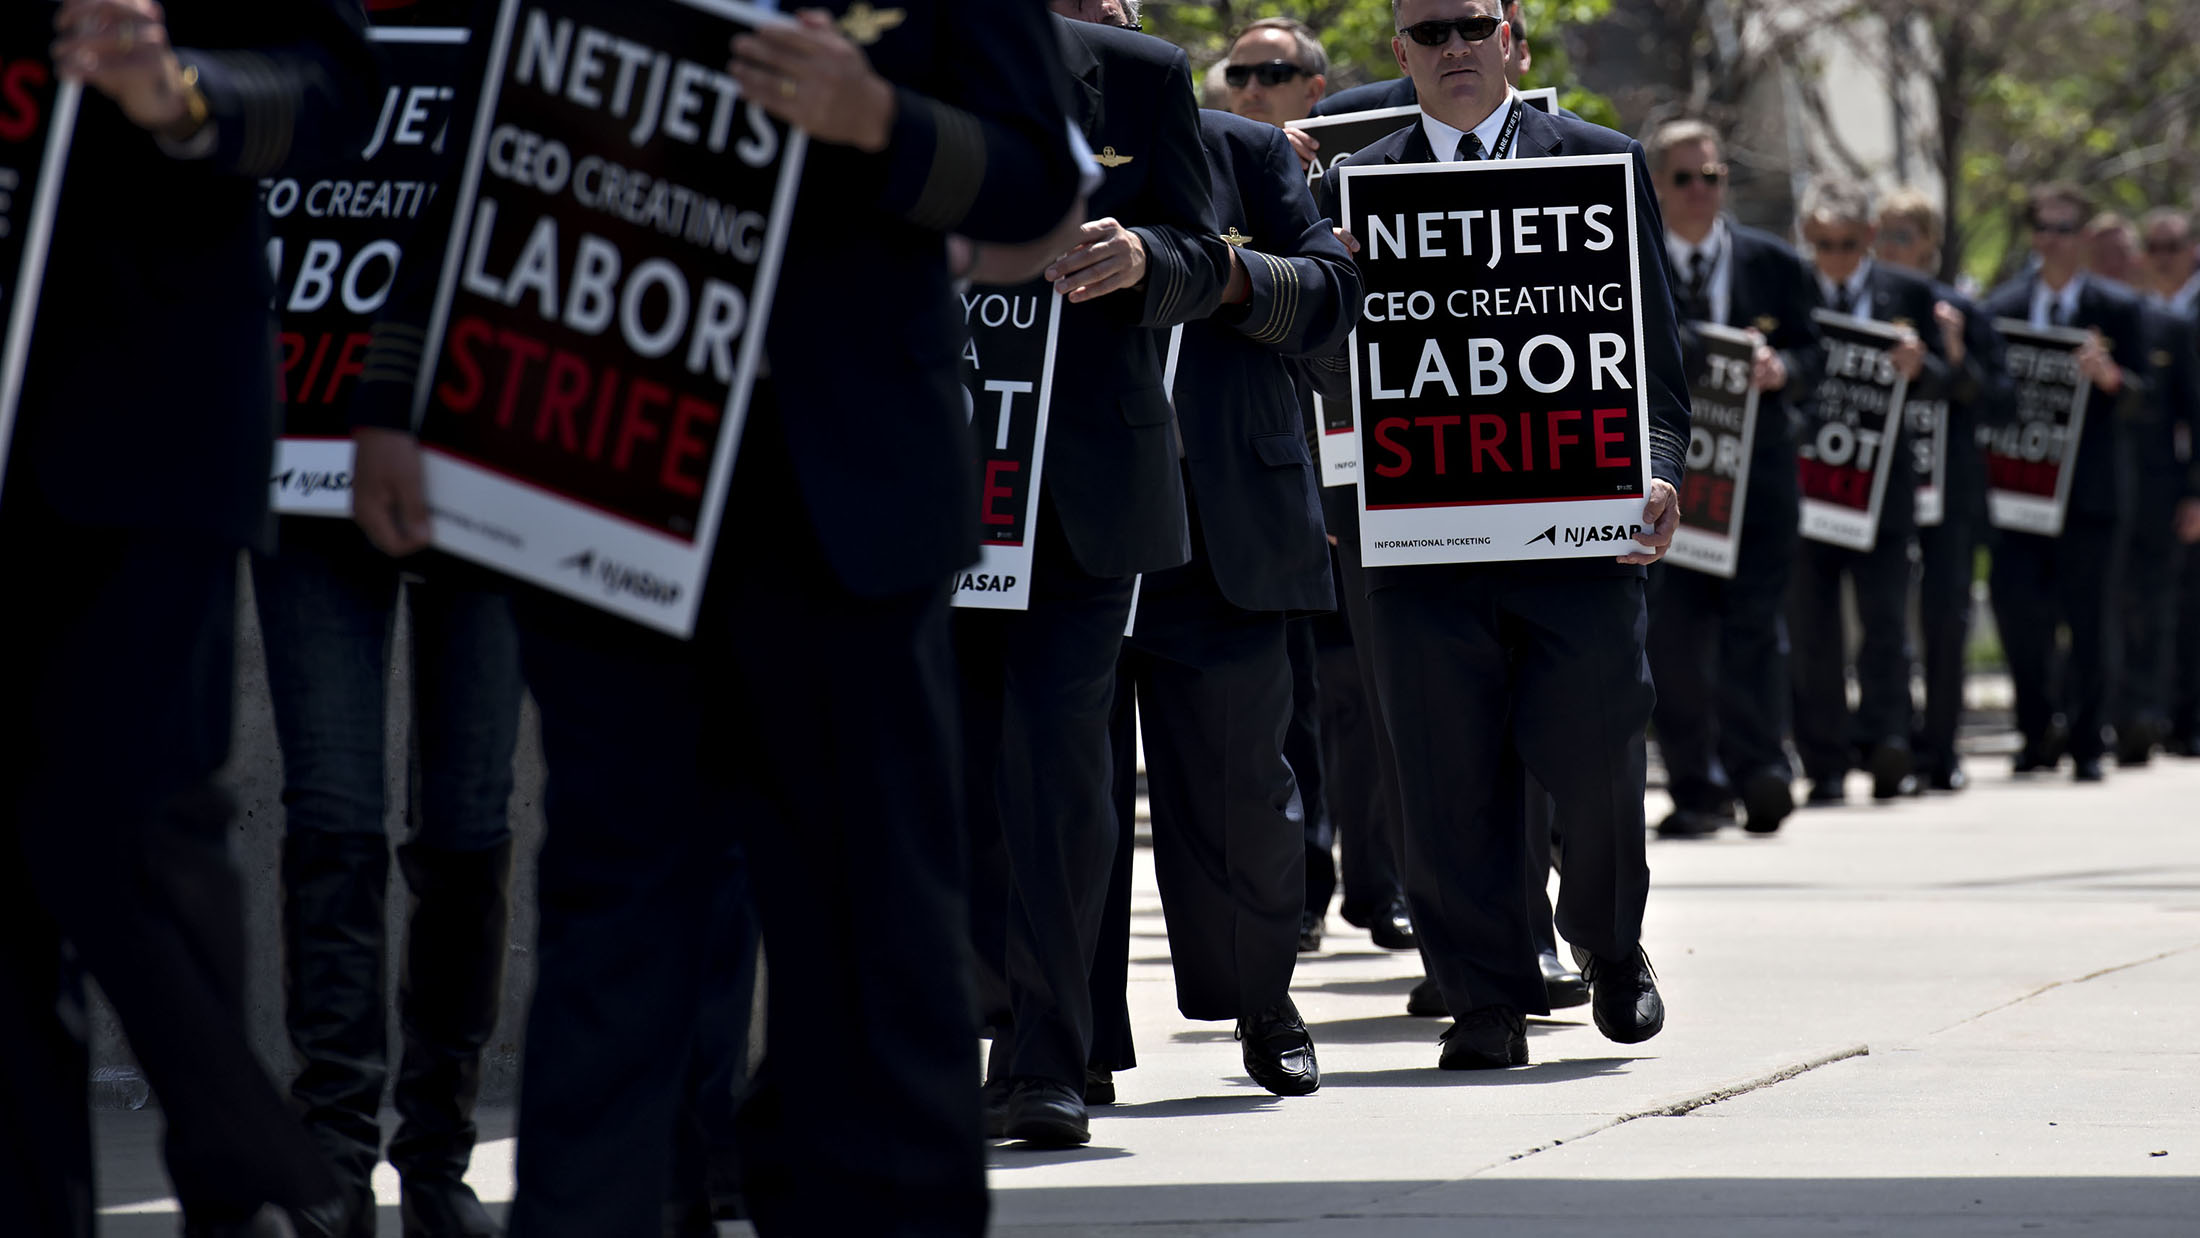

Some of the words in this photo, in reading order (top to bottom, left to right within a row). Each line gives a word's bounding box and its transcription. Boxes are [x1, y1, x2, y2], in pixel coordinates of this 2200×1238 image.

[516, 8, 779, 168] NETJETS
[1499, 137, 1509, 152] ARE
[305, 179, 437, 218] CREATI
[487, 124, 570, 195] CEO
[573, 155, 767, 263] CREATING
[1368, 204, 1614, 269] NETJETS
[461, 197, 747, 383] LABOR
[960, 293, 1038, 329] YOU
[1363, 289, 1435, 322] CEO
[1447, 283, 1623, 318] CREATING
[1369, 332, 1632, 400] LABOR
[437, 315, 720, 496] STRIFE
[1374, 408, 1631, 478] STRIFE
[1374, 539, 1445, 549] INFORMATIONAL
[1447, 536, 1491, 546] PICKETING
[1564, 523, 1642, 547] NJASAP
